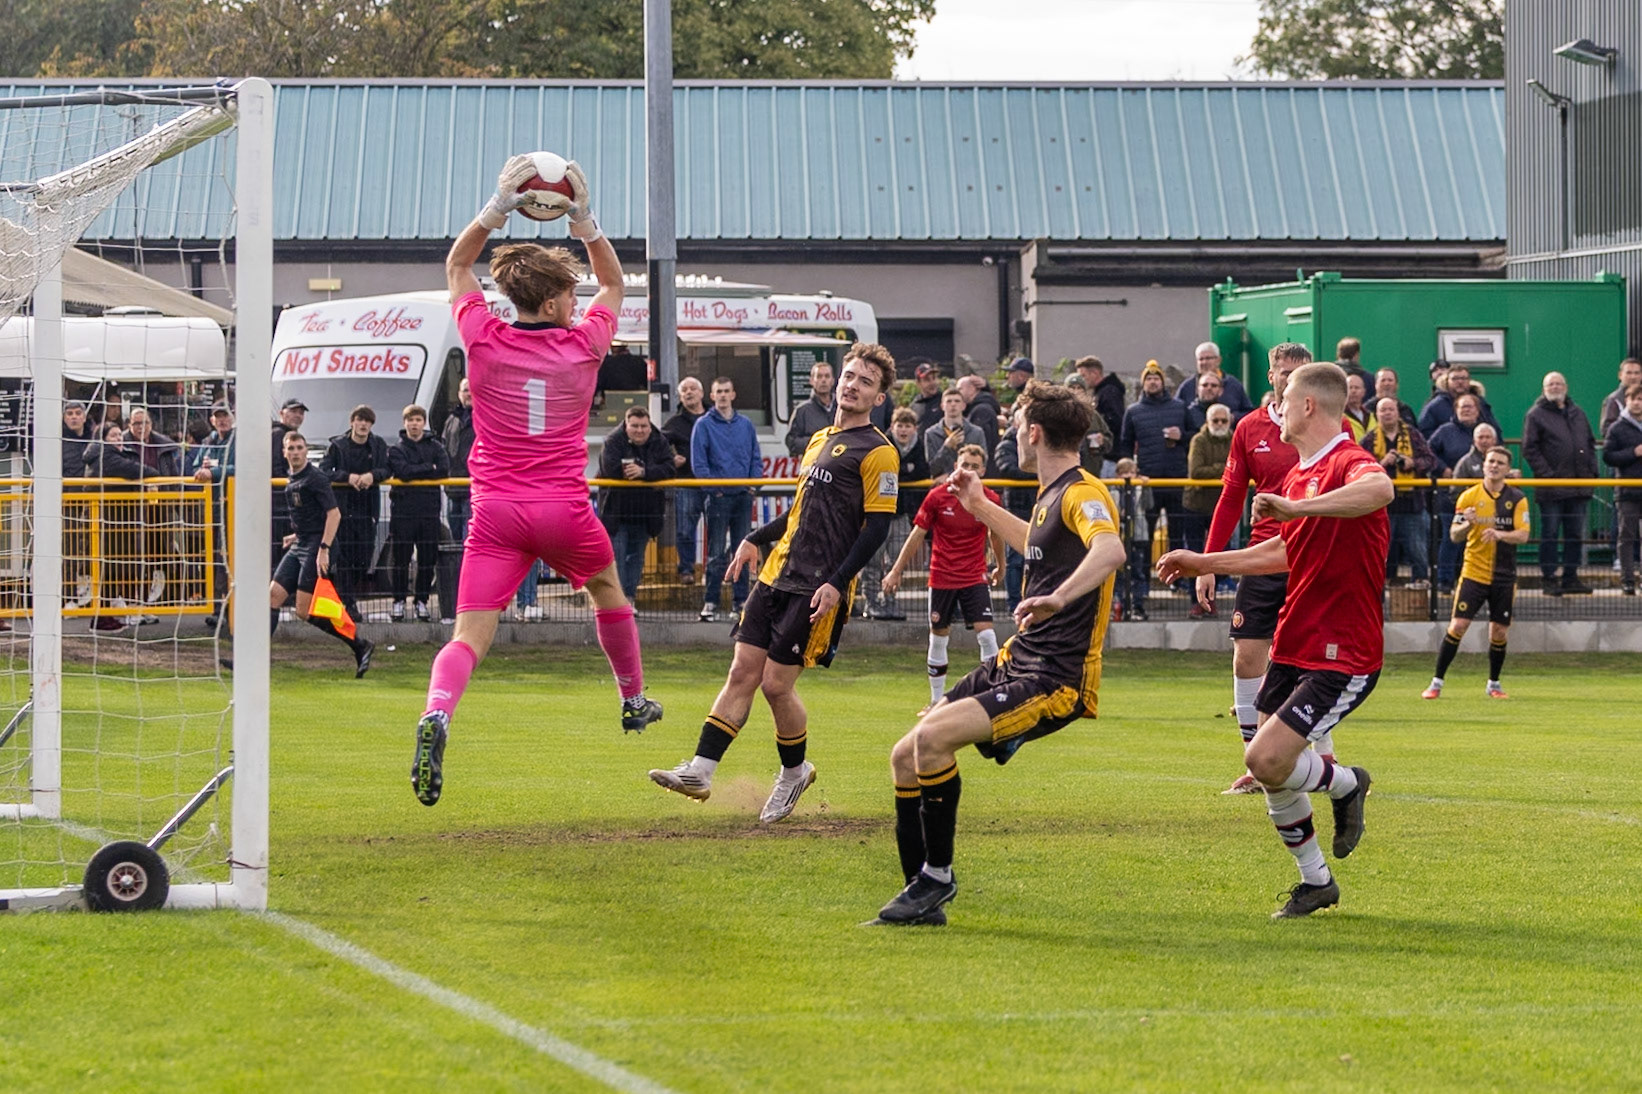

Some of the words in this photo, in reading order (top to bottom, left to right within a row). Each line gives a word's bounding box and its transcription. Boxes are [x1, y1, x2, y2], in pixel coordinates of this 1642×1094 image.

[299, 311, 330, 333] Tea
[352, 307, 423, 338] Coffee
[683, 301, 707, 320] Hot
[711, 301, 749, 324] Dogs
[767, 301, 809, 321] Bacon
[814, 302, 852, 321] Rolls
[282, 351, 321, 375] No1
[327, 349, 411, 373] Snacks
[522, 378, 546, 435] 1
